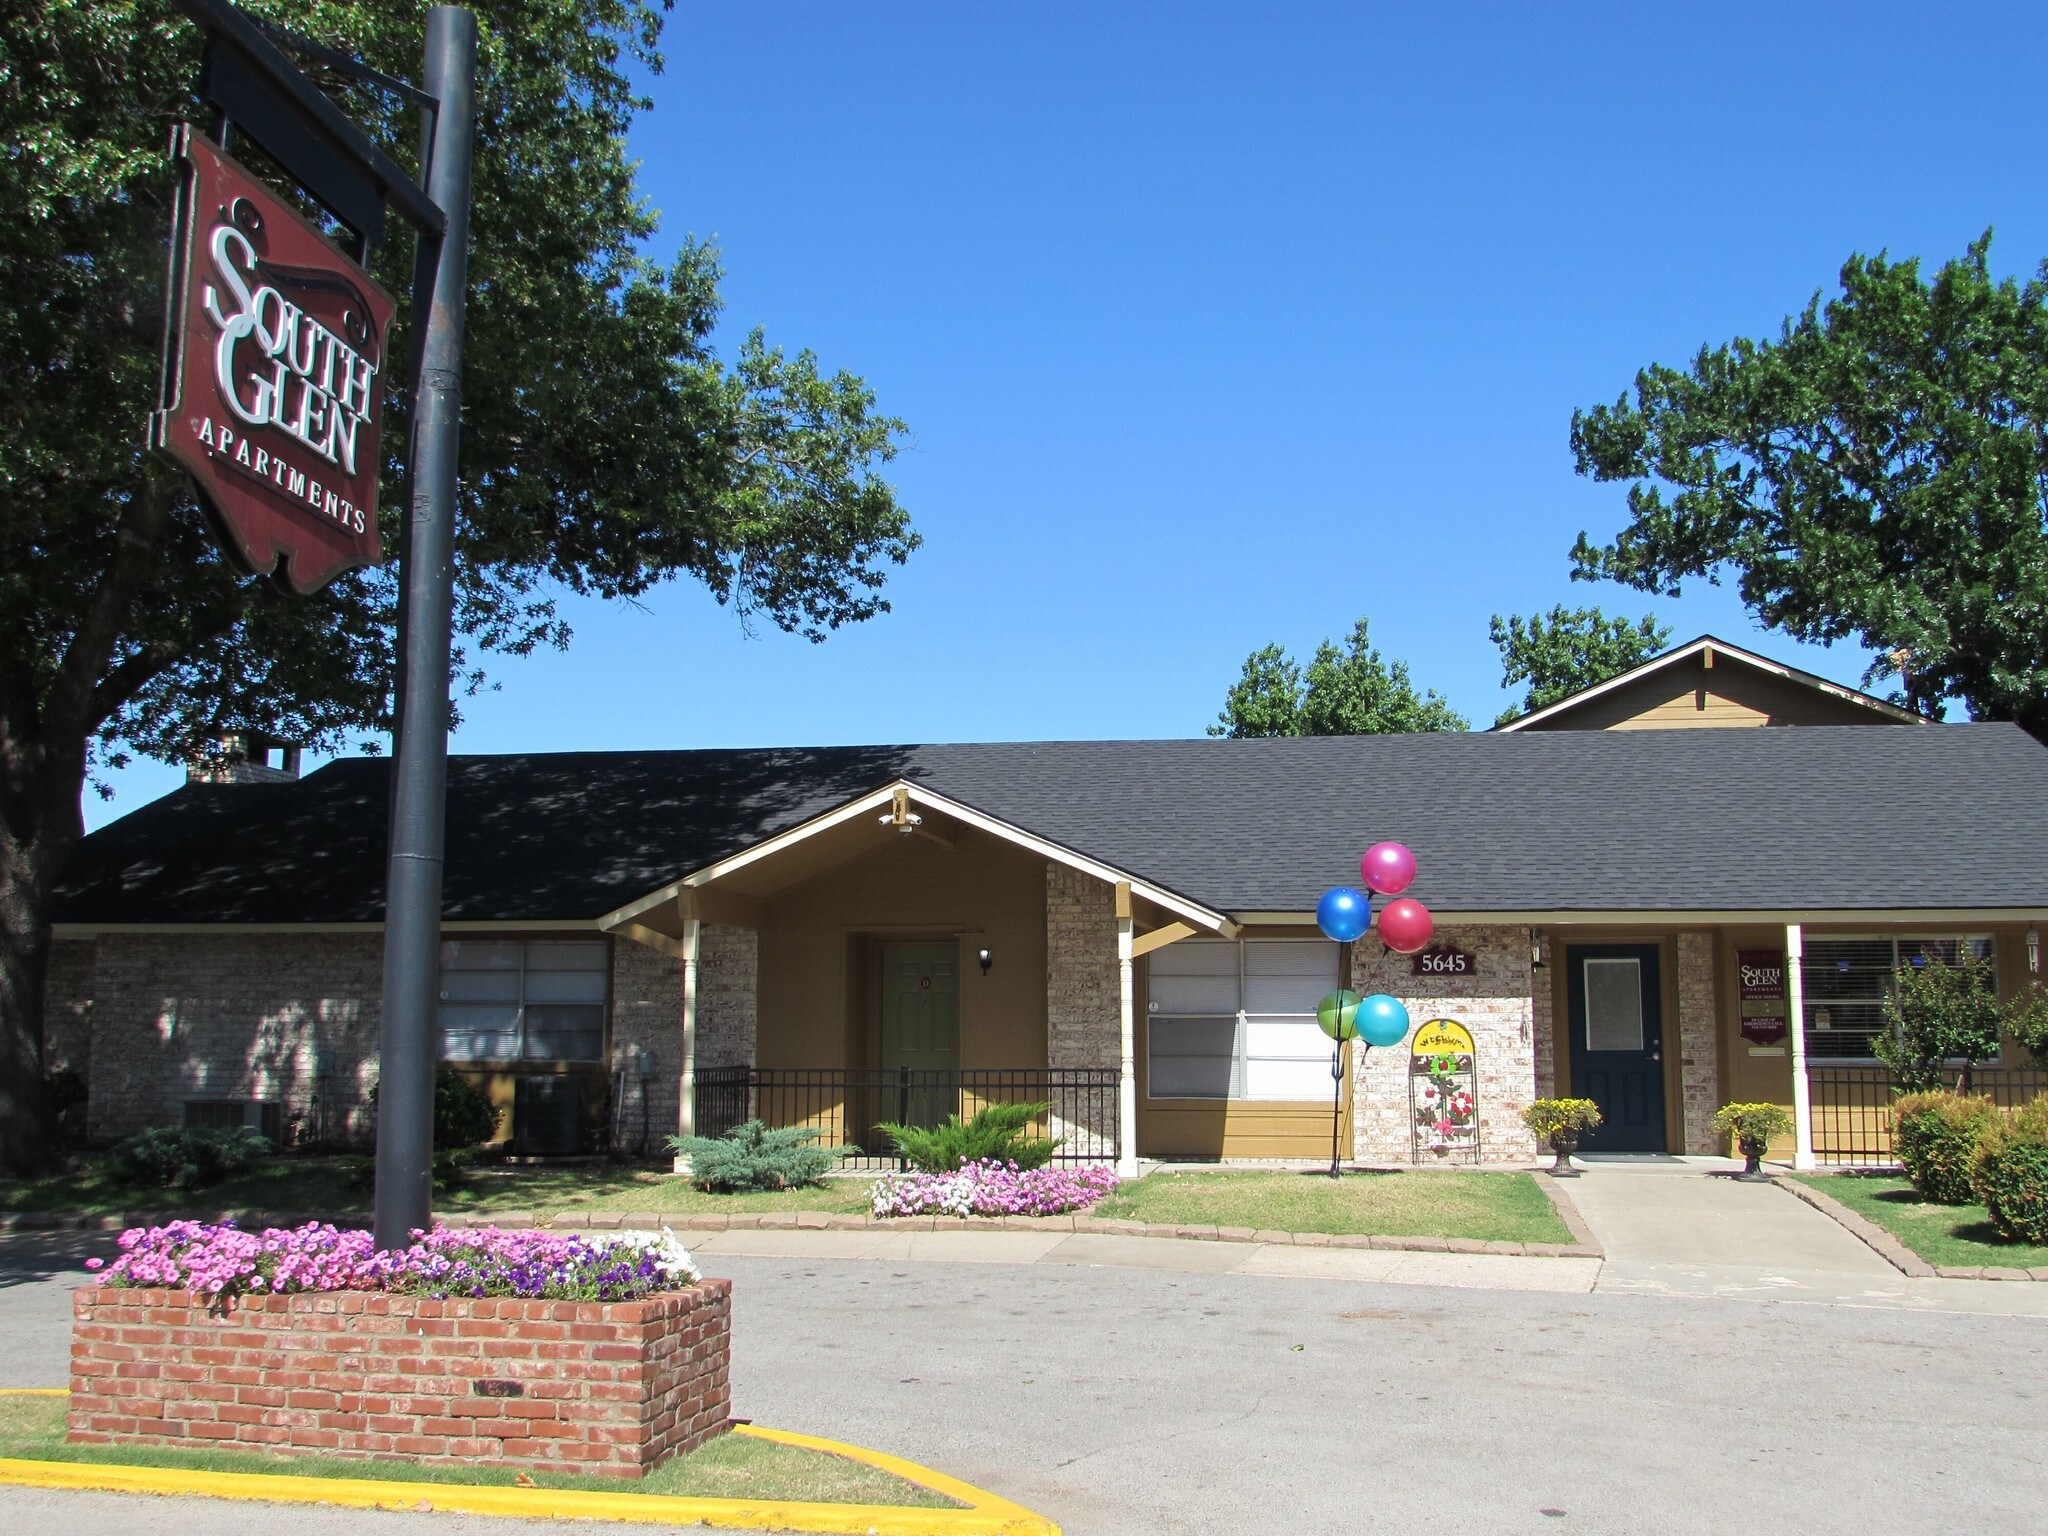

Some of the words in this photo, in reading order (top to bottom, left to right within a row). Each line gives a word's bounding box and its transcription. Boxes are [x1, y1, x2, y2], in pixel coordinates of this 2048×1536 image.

[205, 226, 377, 424] SOUTH
[213, 313, 358, 476] GLEN
[198, 416, 367, 535] APARTMENTS
[1422, 954, 1466, 972] 5645
[1741, 965, 1780, 978] SOUTH
[1745, 975, 1777, 986] GLEN
